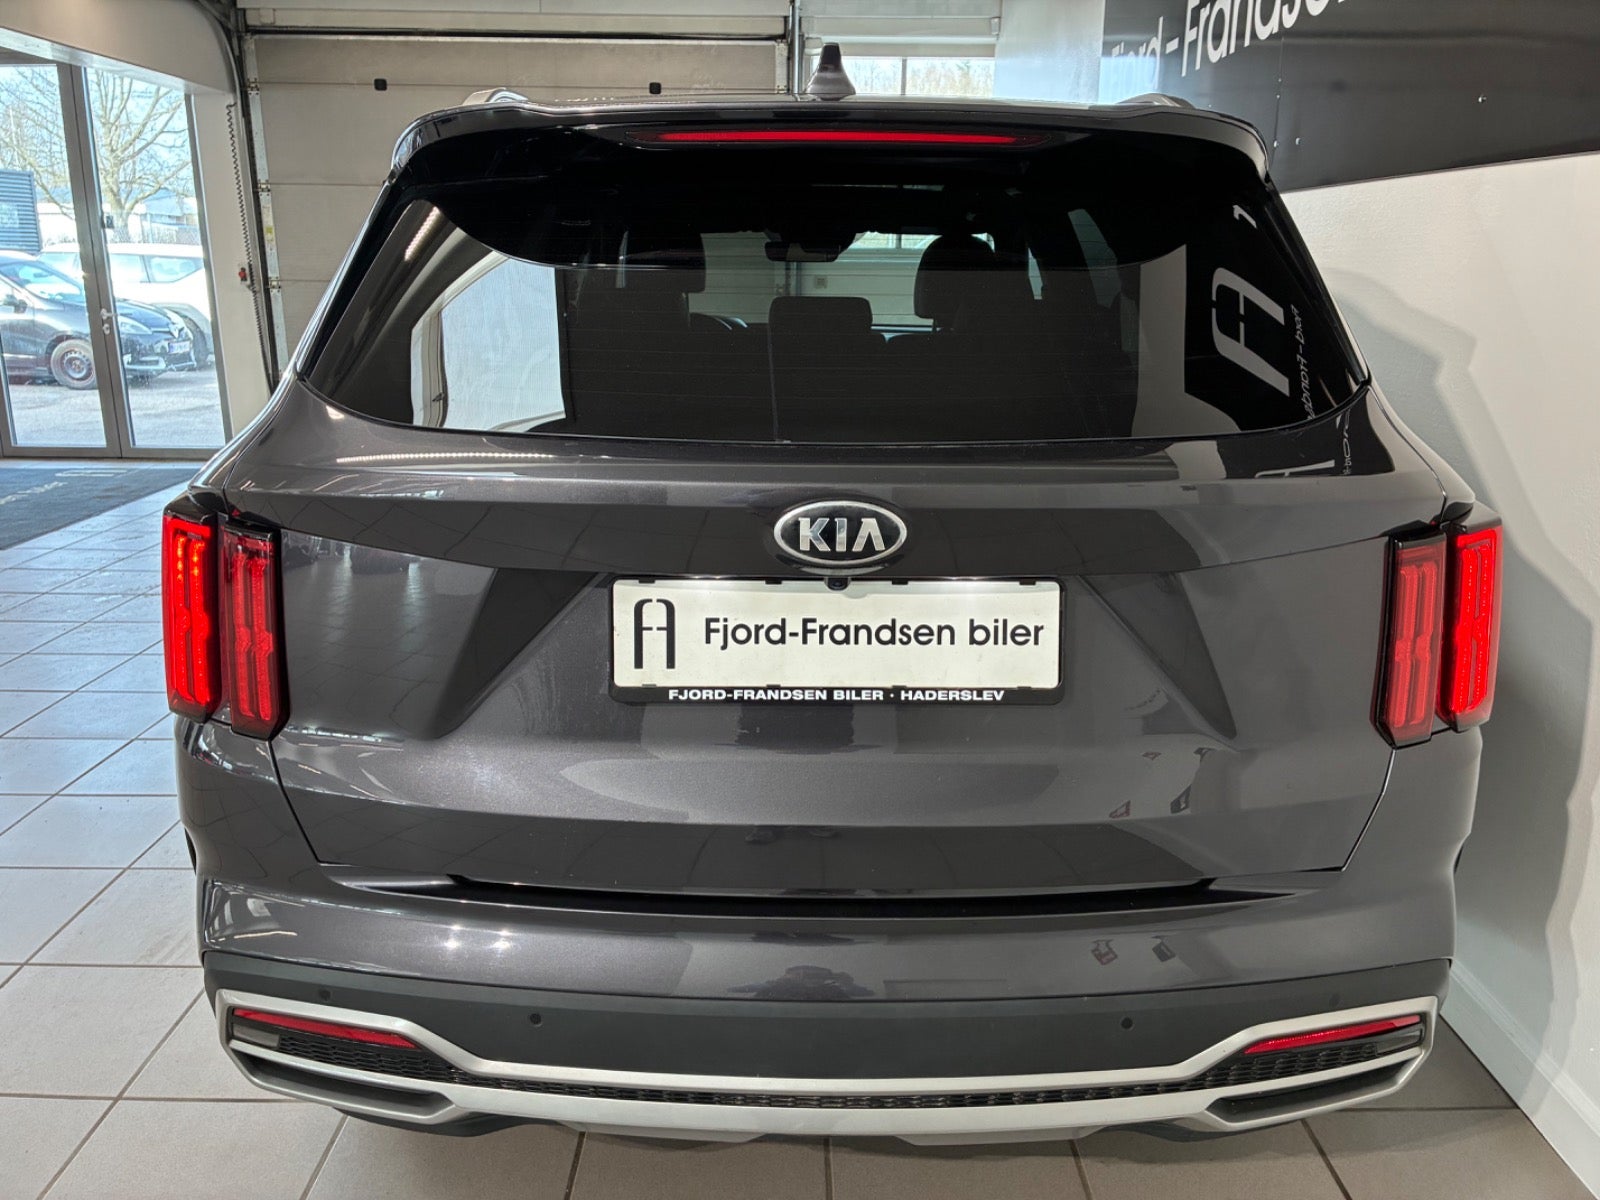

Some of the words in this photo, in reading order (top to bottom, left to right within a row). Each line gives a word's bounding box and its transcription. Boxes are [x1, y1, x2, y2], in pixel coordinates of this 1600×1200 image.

[798, 517, 886, 552] KIA
[704, 617, 956, 651] Fjord-Frandsen
[968, 618, 1044, 646] biler
[668, 689, 827, 701] FJORD-FRANDSEN
[833, 689, 884, 701] BILER
[900, 690, 1005, 702] HADERSLEV
